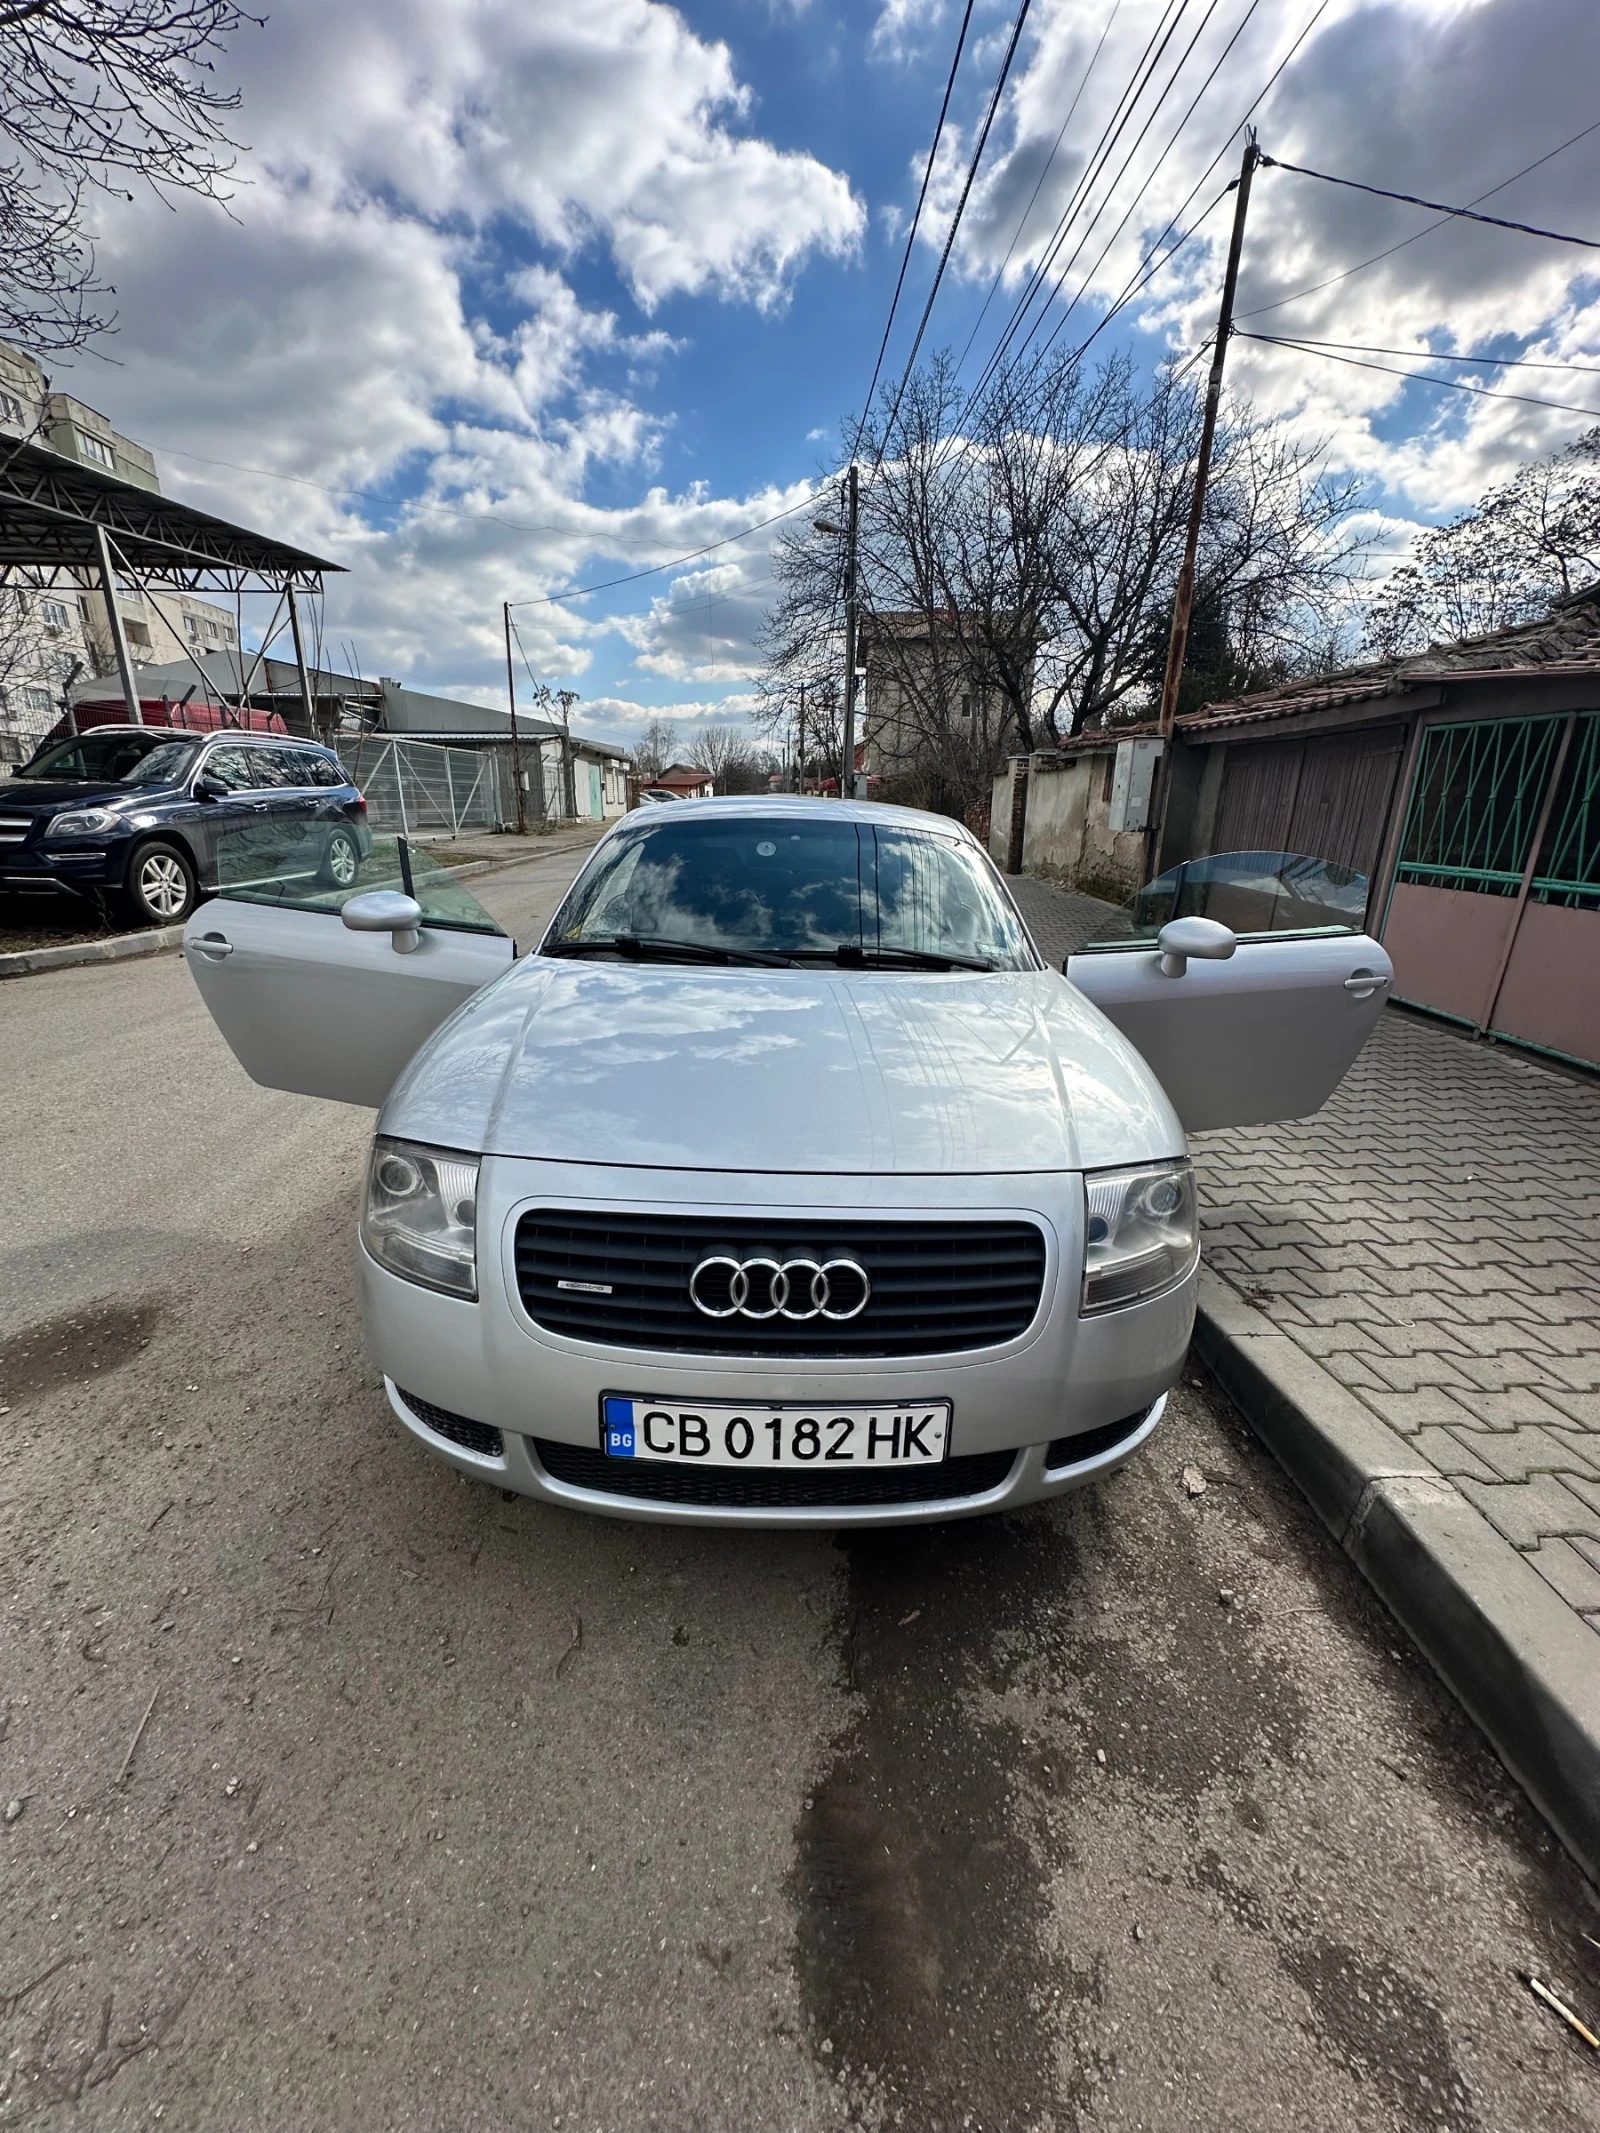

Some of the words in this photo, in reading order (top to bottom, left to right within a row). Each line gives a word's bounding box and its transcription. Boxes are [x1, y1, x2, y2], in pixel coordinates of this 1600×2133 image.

[610, 1433, 632, 1447] BG
[642, 1411, 711, 1457] CB
[724, 1416, 855, 1460] 0182
[867, 1414, 935, 1459] HK
